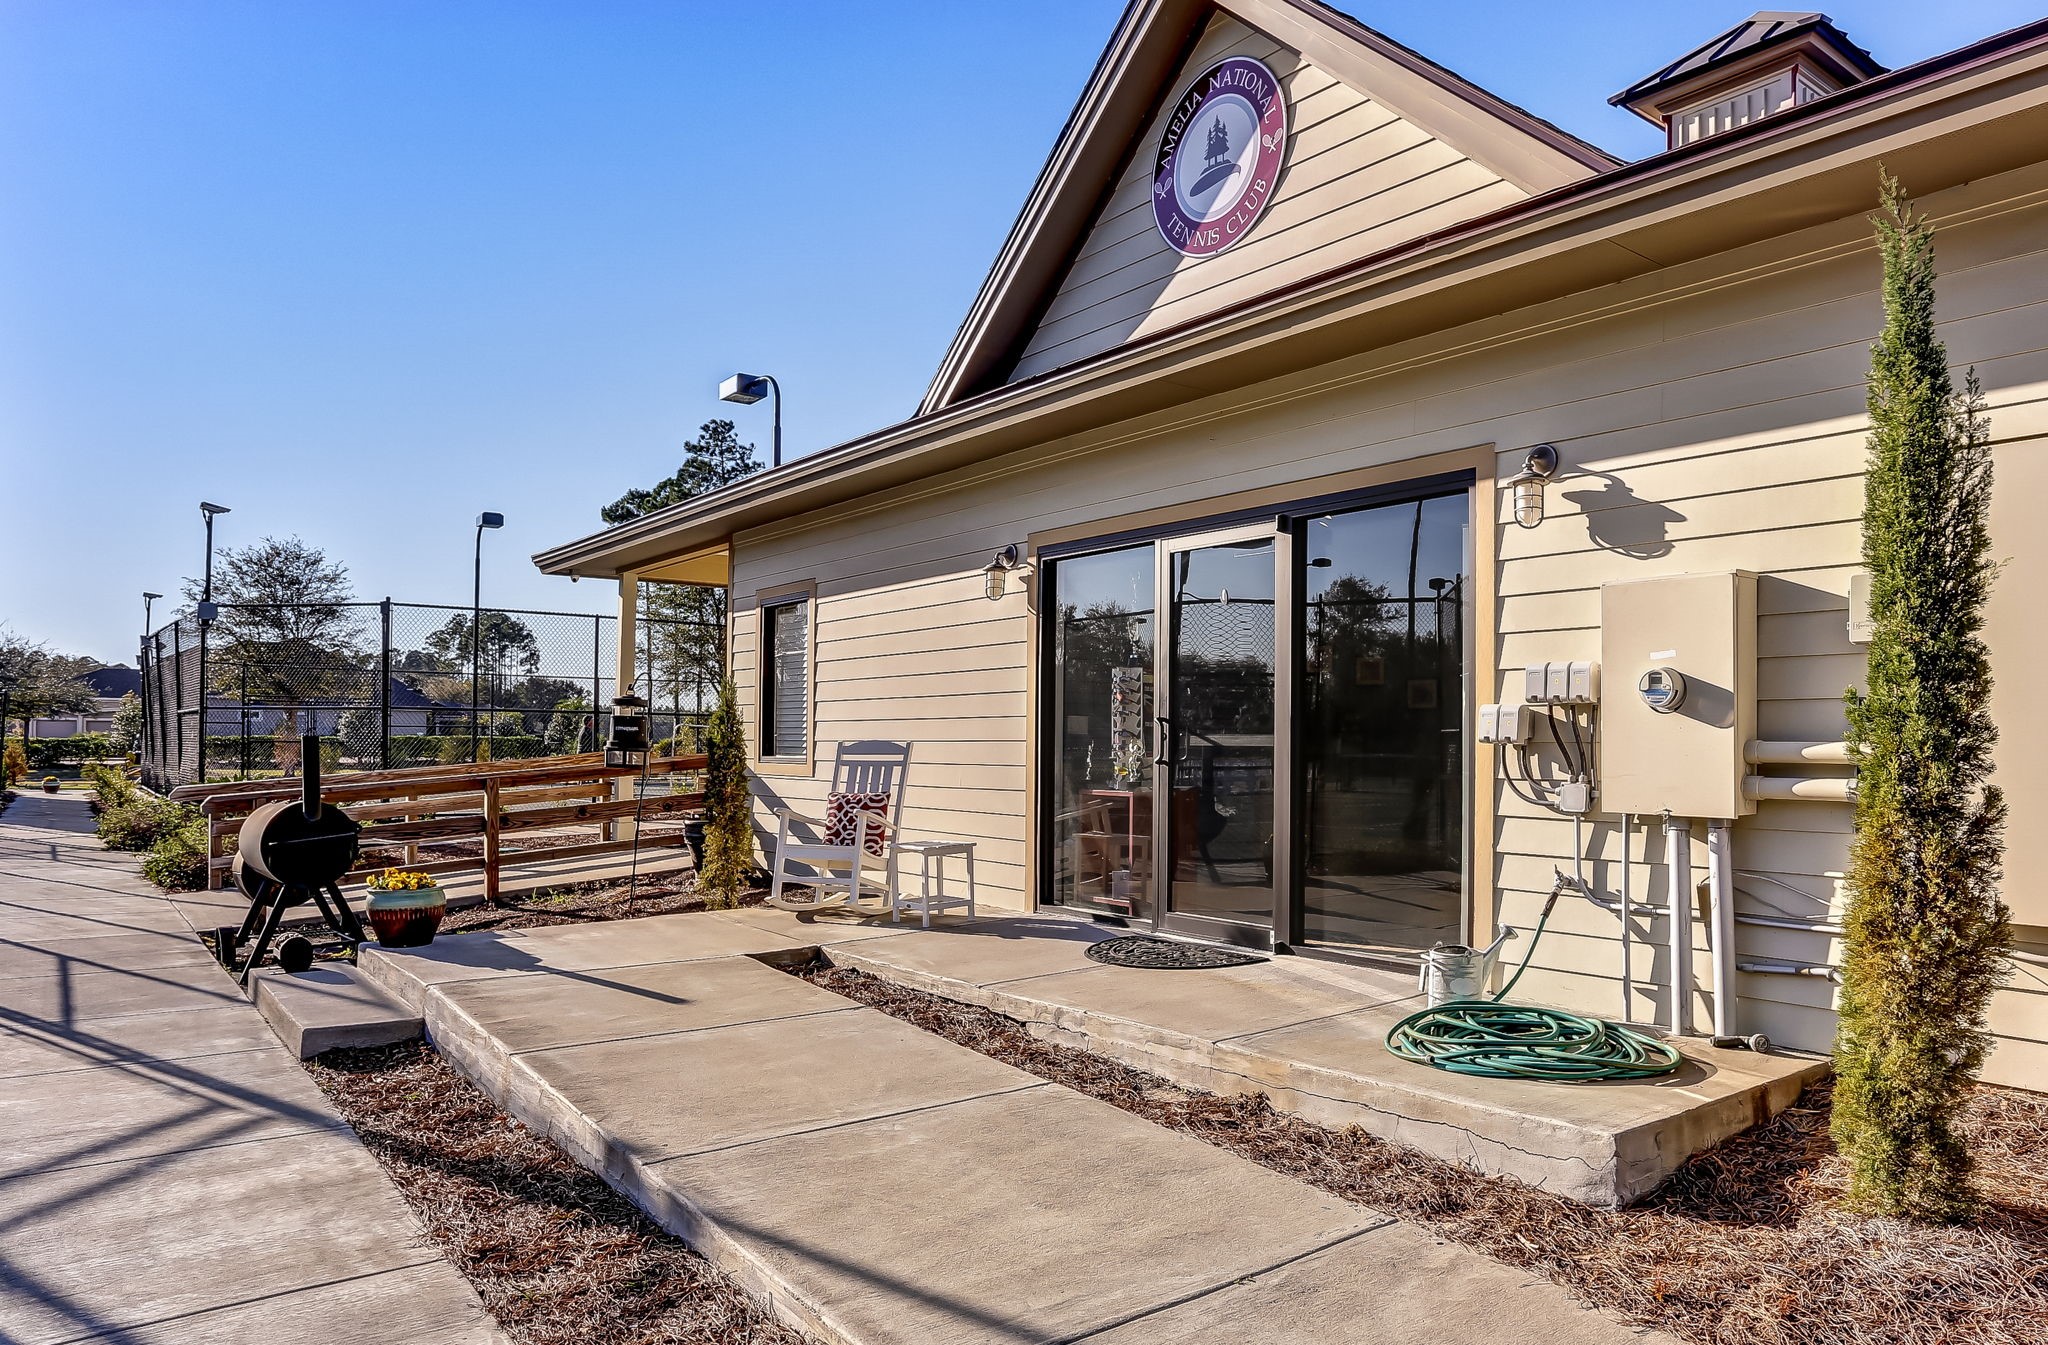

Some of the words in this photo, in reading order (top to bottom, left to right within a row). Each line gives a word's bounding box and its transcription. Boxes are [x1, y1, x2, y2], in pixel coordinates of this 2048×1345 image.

[1161, 92, 1204, 170] AMELIA
[1208, 68, 1277, 124] NATIONAL
[1166, 212, 1220, 247] TENNIS
[1226, 178, 1267, 234] CLUB
